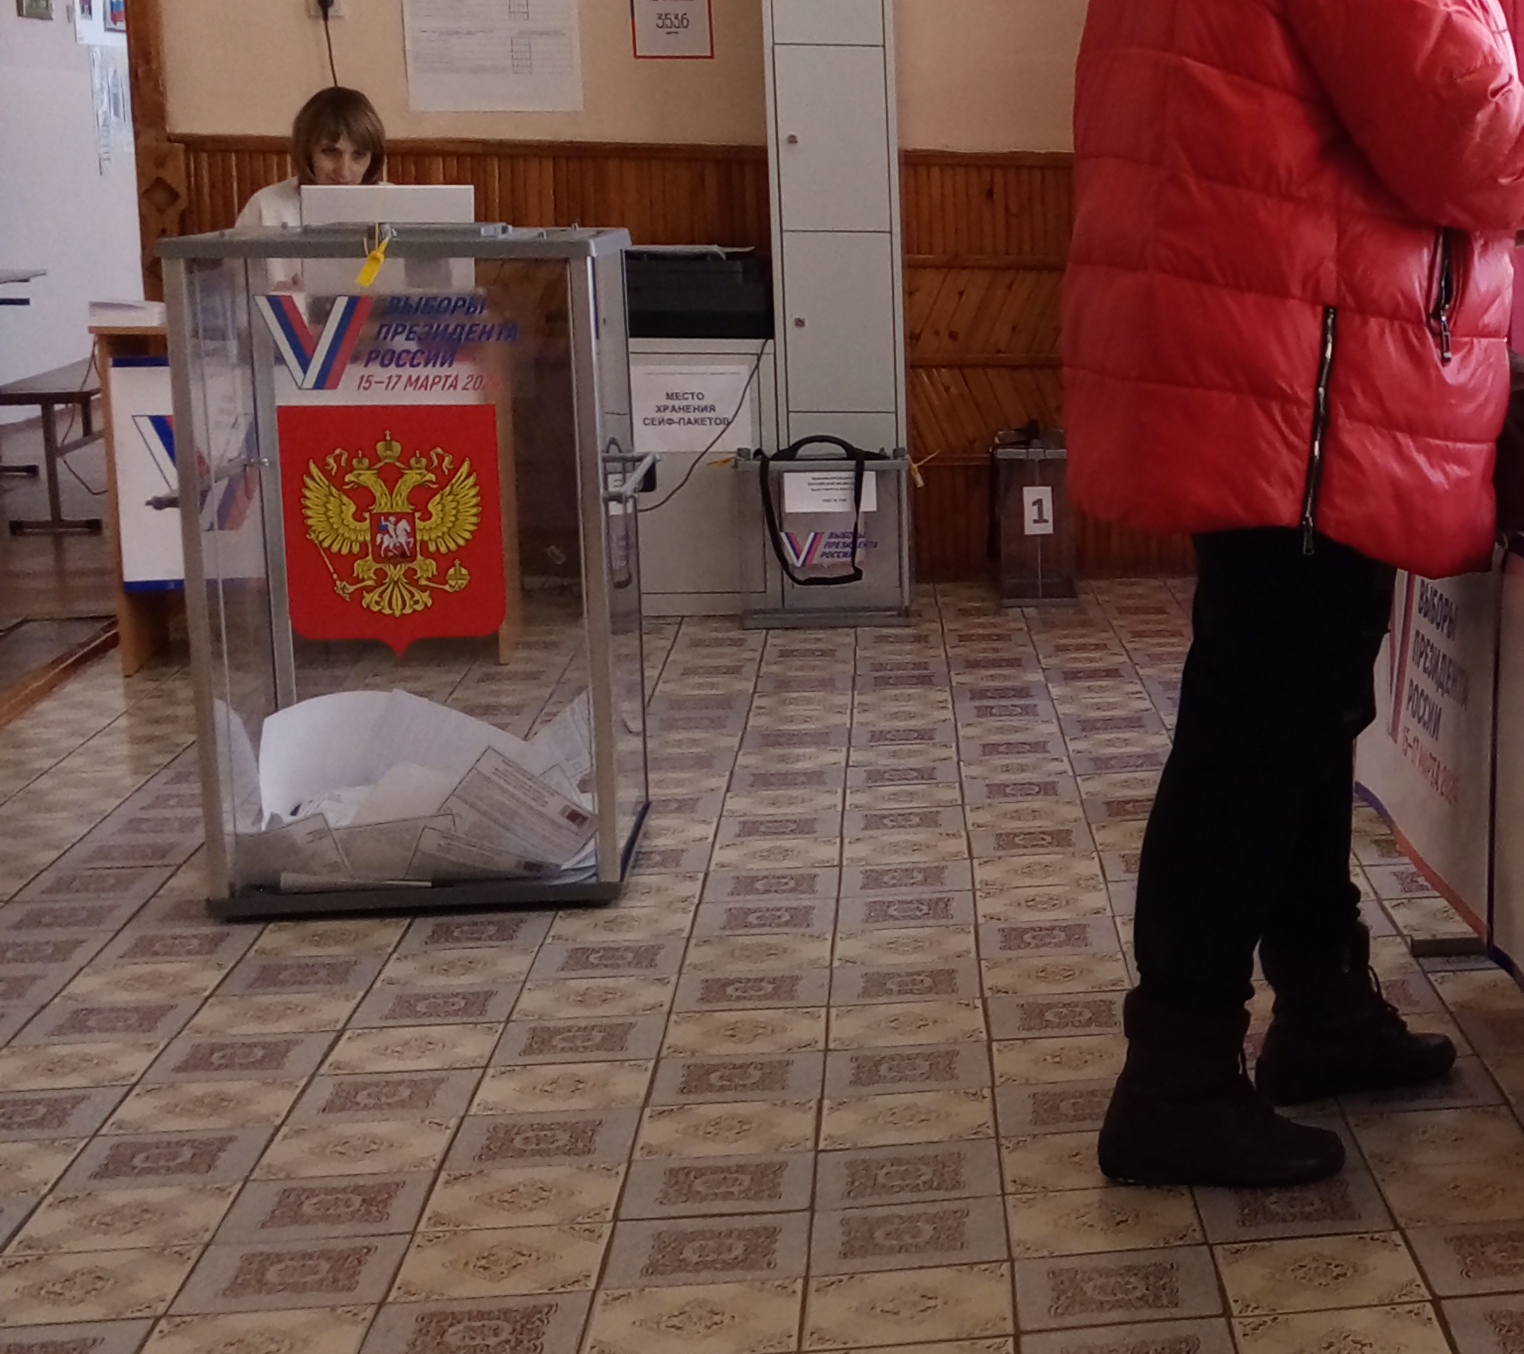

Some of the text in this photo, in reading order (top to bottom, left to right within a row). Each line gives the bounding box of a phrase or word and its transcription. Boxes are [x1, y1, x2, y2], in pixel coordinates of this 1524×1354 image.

[655, 12, 690, 29] 3536
[385, 296, 487, 316] ВЫБОРЫ
[376, 322, 520, 344] ПРЕЗИДЕНТА
[363, 348, 459, 368] РОССИИ
[404, 374, 458, 392] МАРТА
[665, 391, 705, 401] МЕСТО
[655, 404, 716, 414] ХРАНЕНИЯ
[643, 416, 730, 426] СЕЙФ-ПАКЕТОВ
[1031, 497, 1050, 525] 1
[1417, 578, 1459, 642] ВЫБОРЫ
[1406, 677, 1443, 742] РОССИИ
